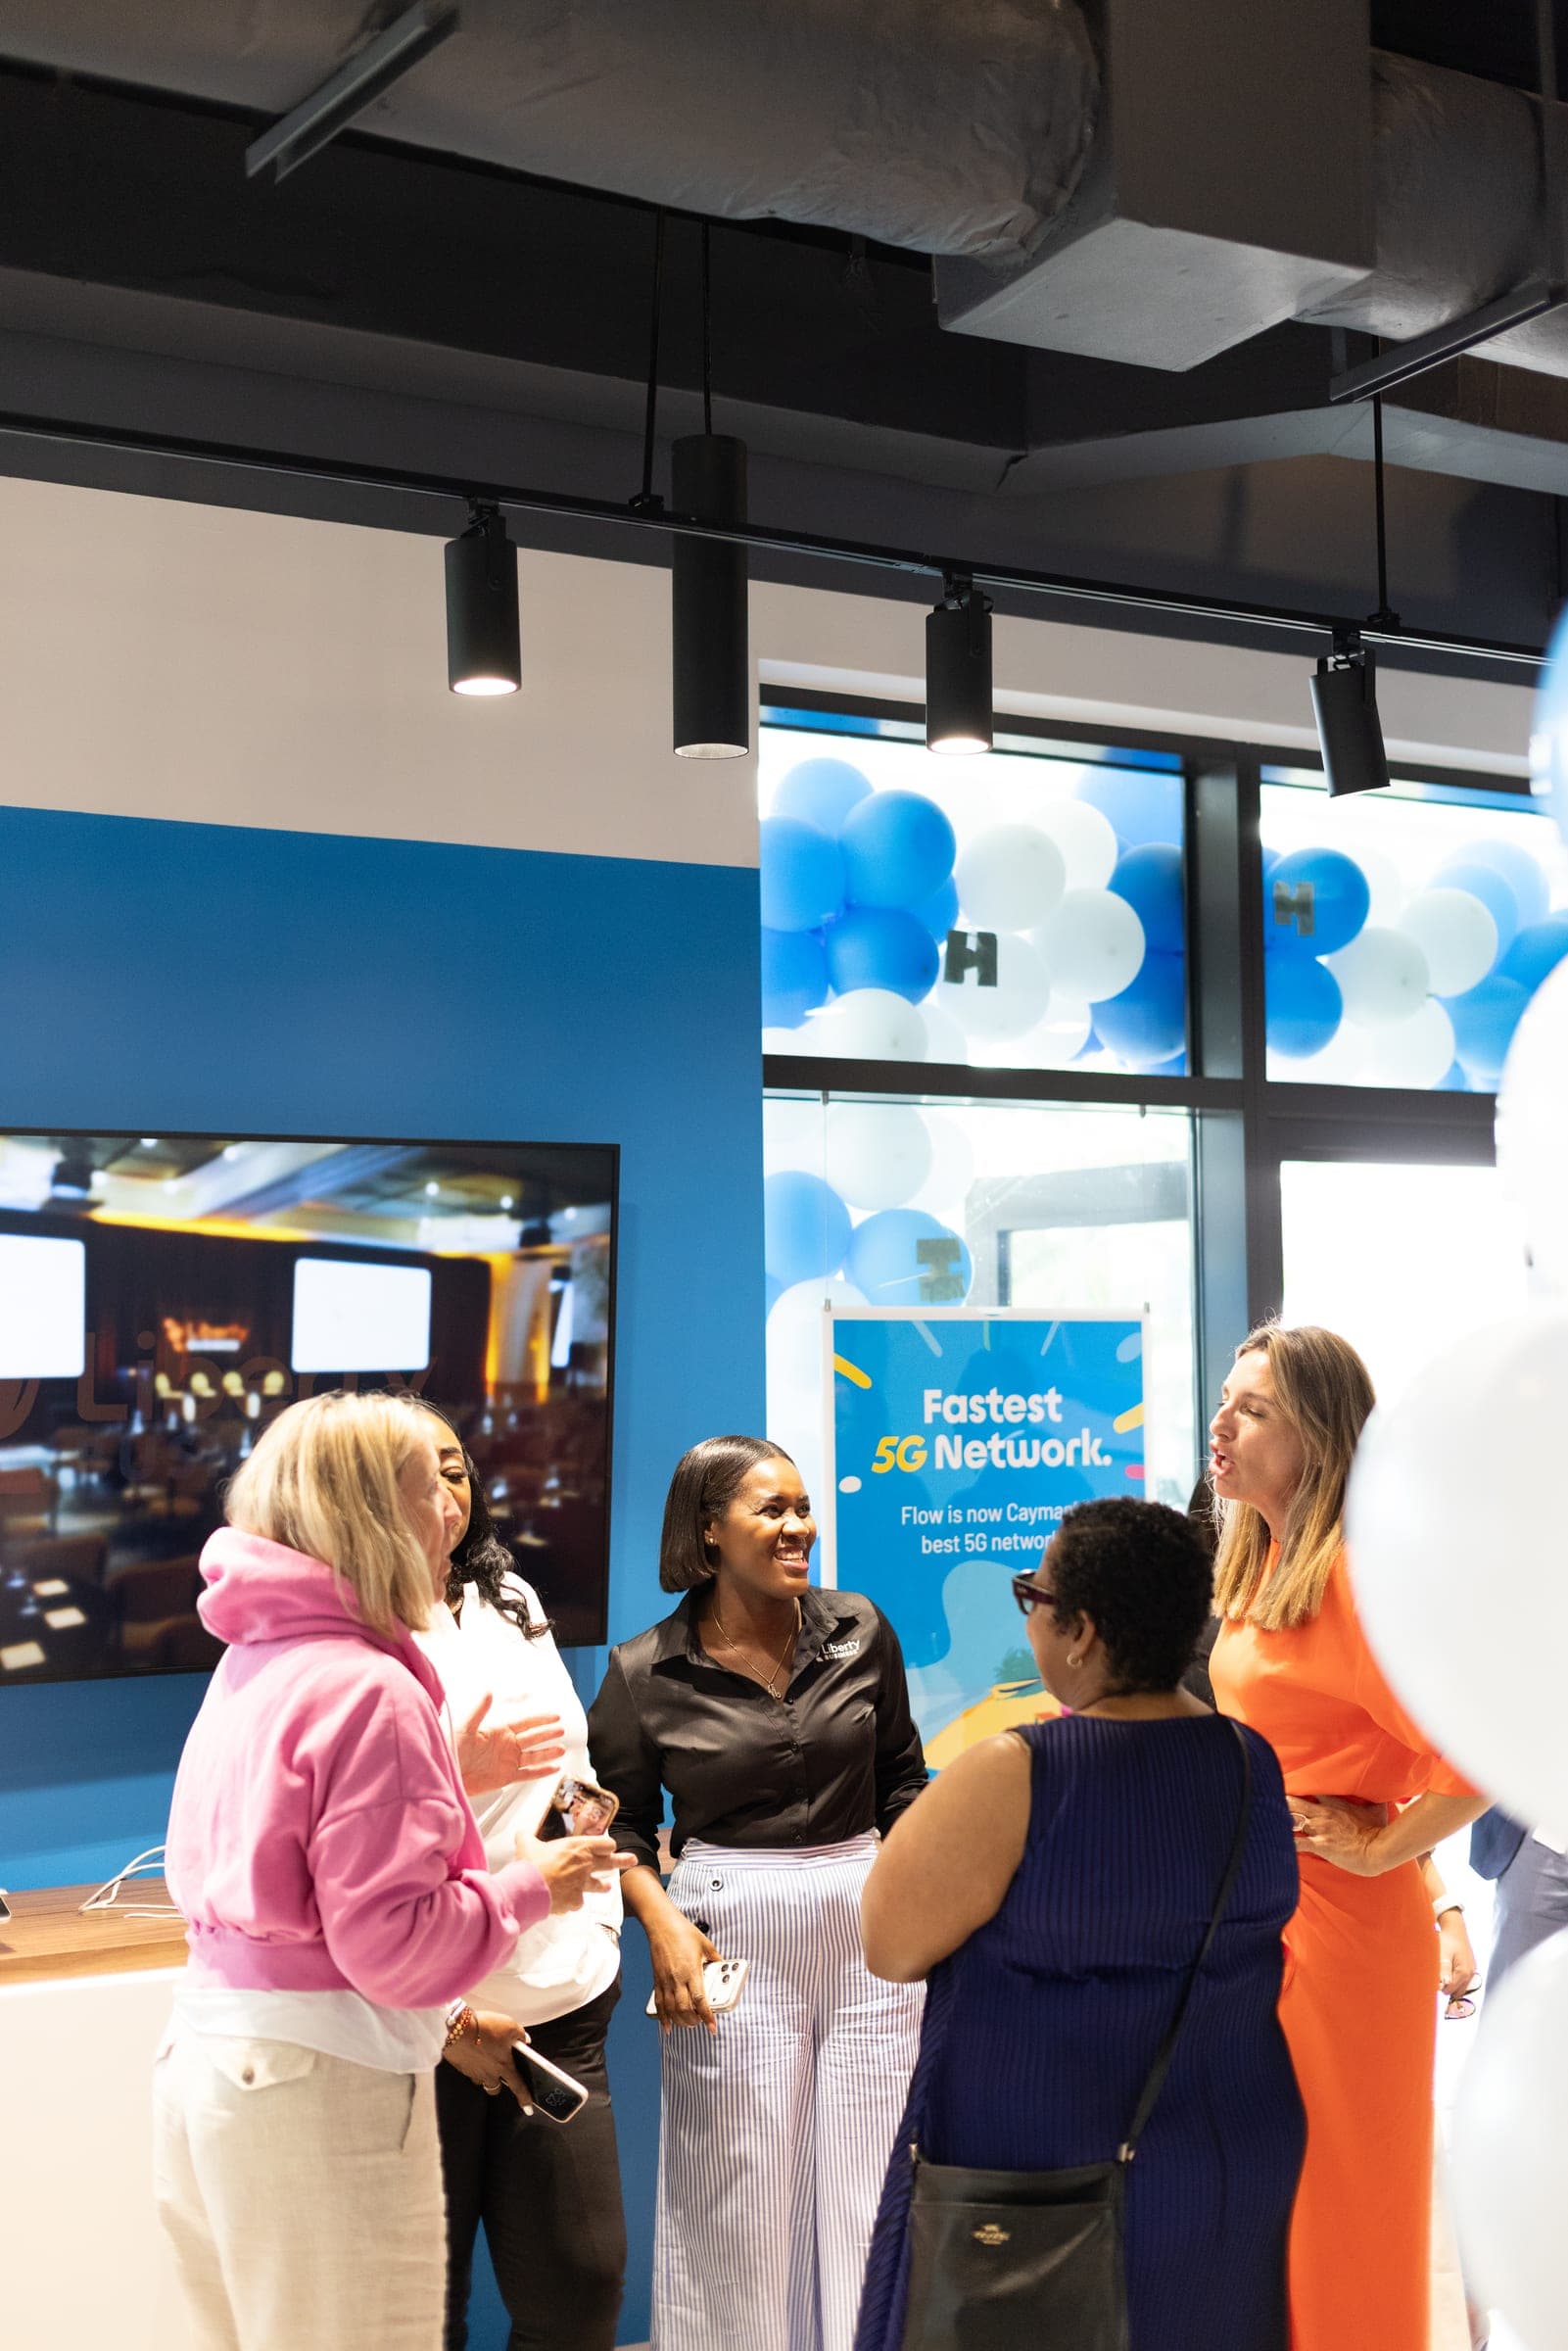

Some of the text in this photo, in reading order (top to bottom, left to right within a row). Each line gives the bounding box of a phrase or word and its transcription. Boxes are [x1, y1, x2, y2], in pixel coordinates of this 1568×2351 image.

[924, 1387, 1063, 1424] Fastest
[871, 1427, 1113, 1473] 5G Network.
[901, 1506, 943, 1525] Flow
[947, 1505, 963, 1523] is
[967, 1508, 1003, 1523] now
[922, 1535, 961, 1554] best
[965, 1533, 987, 1552] 5G
[822, 1640, 861, 1655] Liberty
